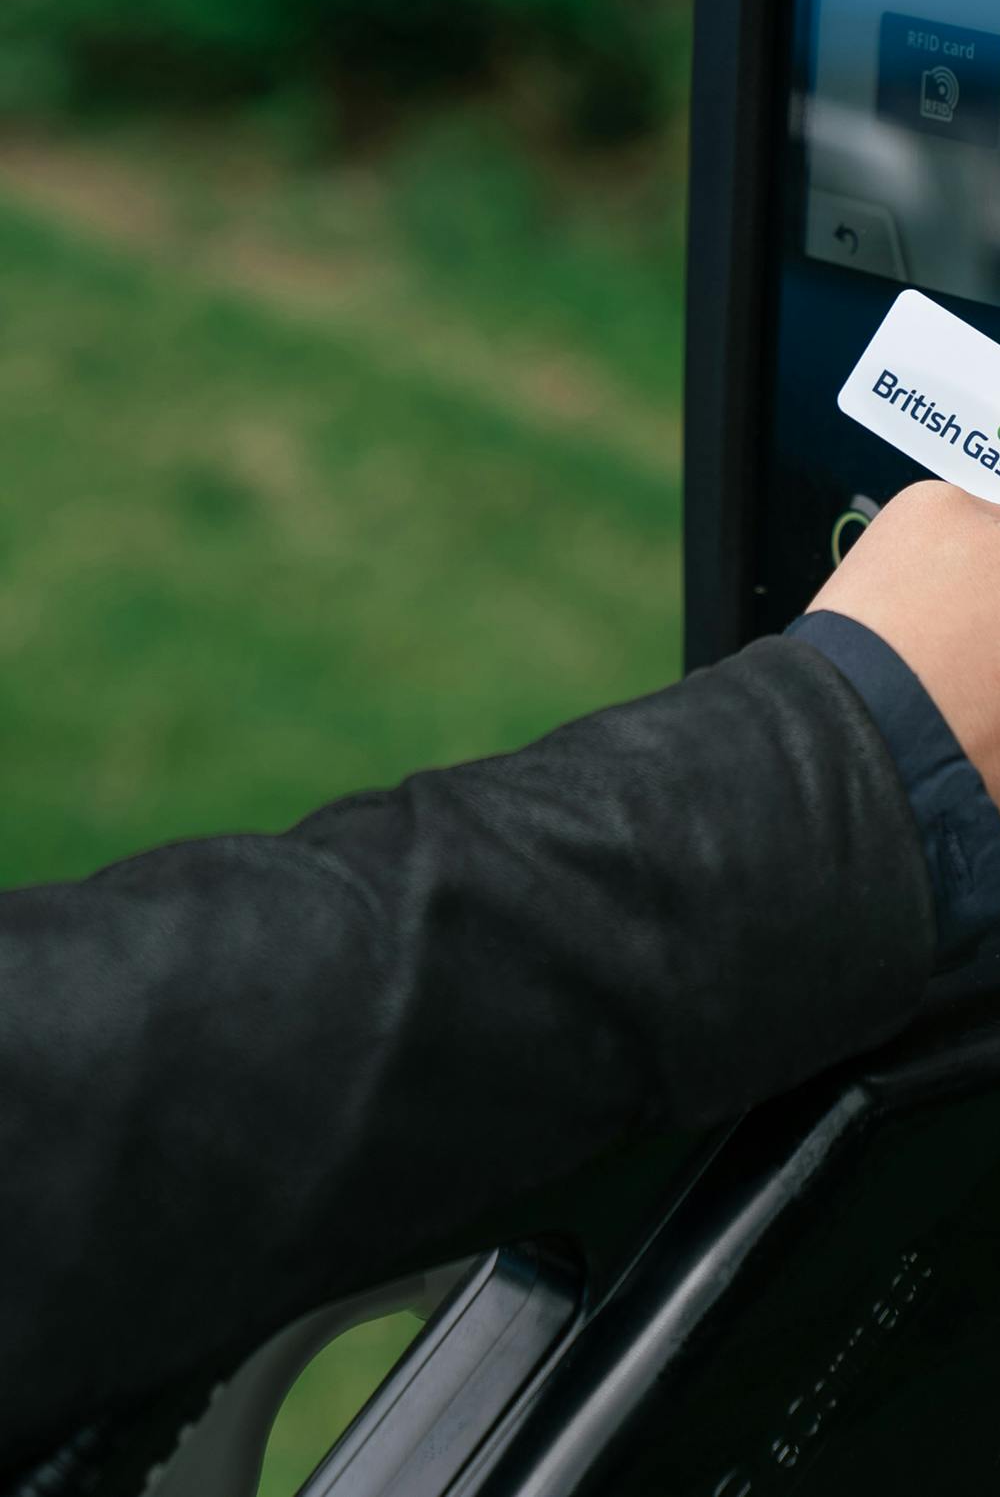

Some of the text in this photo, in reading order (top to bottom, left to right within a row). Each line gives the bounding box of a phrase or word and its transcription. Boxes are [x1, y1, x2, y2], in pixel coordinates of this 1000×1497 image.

[907, 30, 976, 60] RFID card
[871, 369, 962, 445] British
